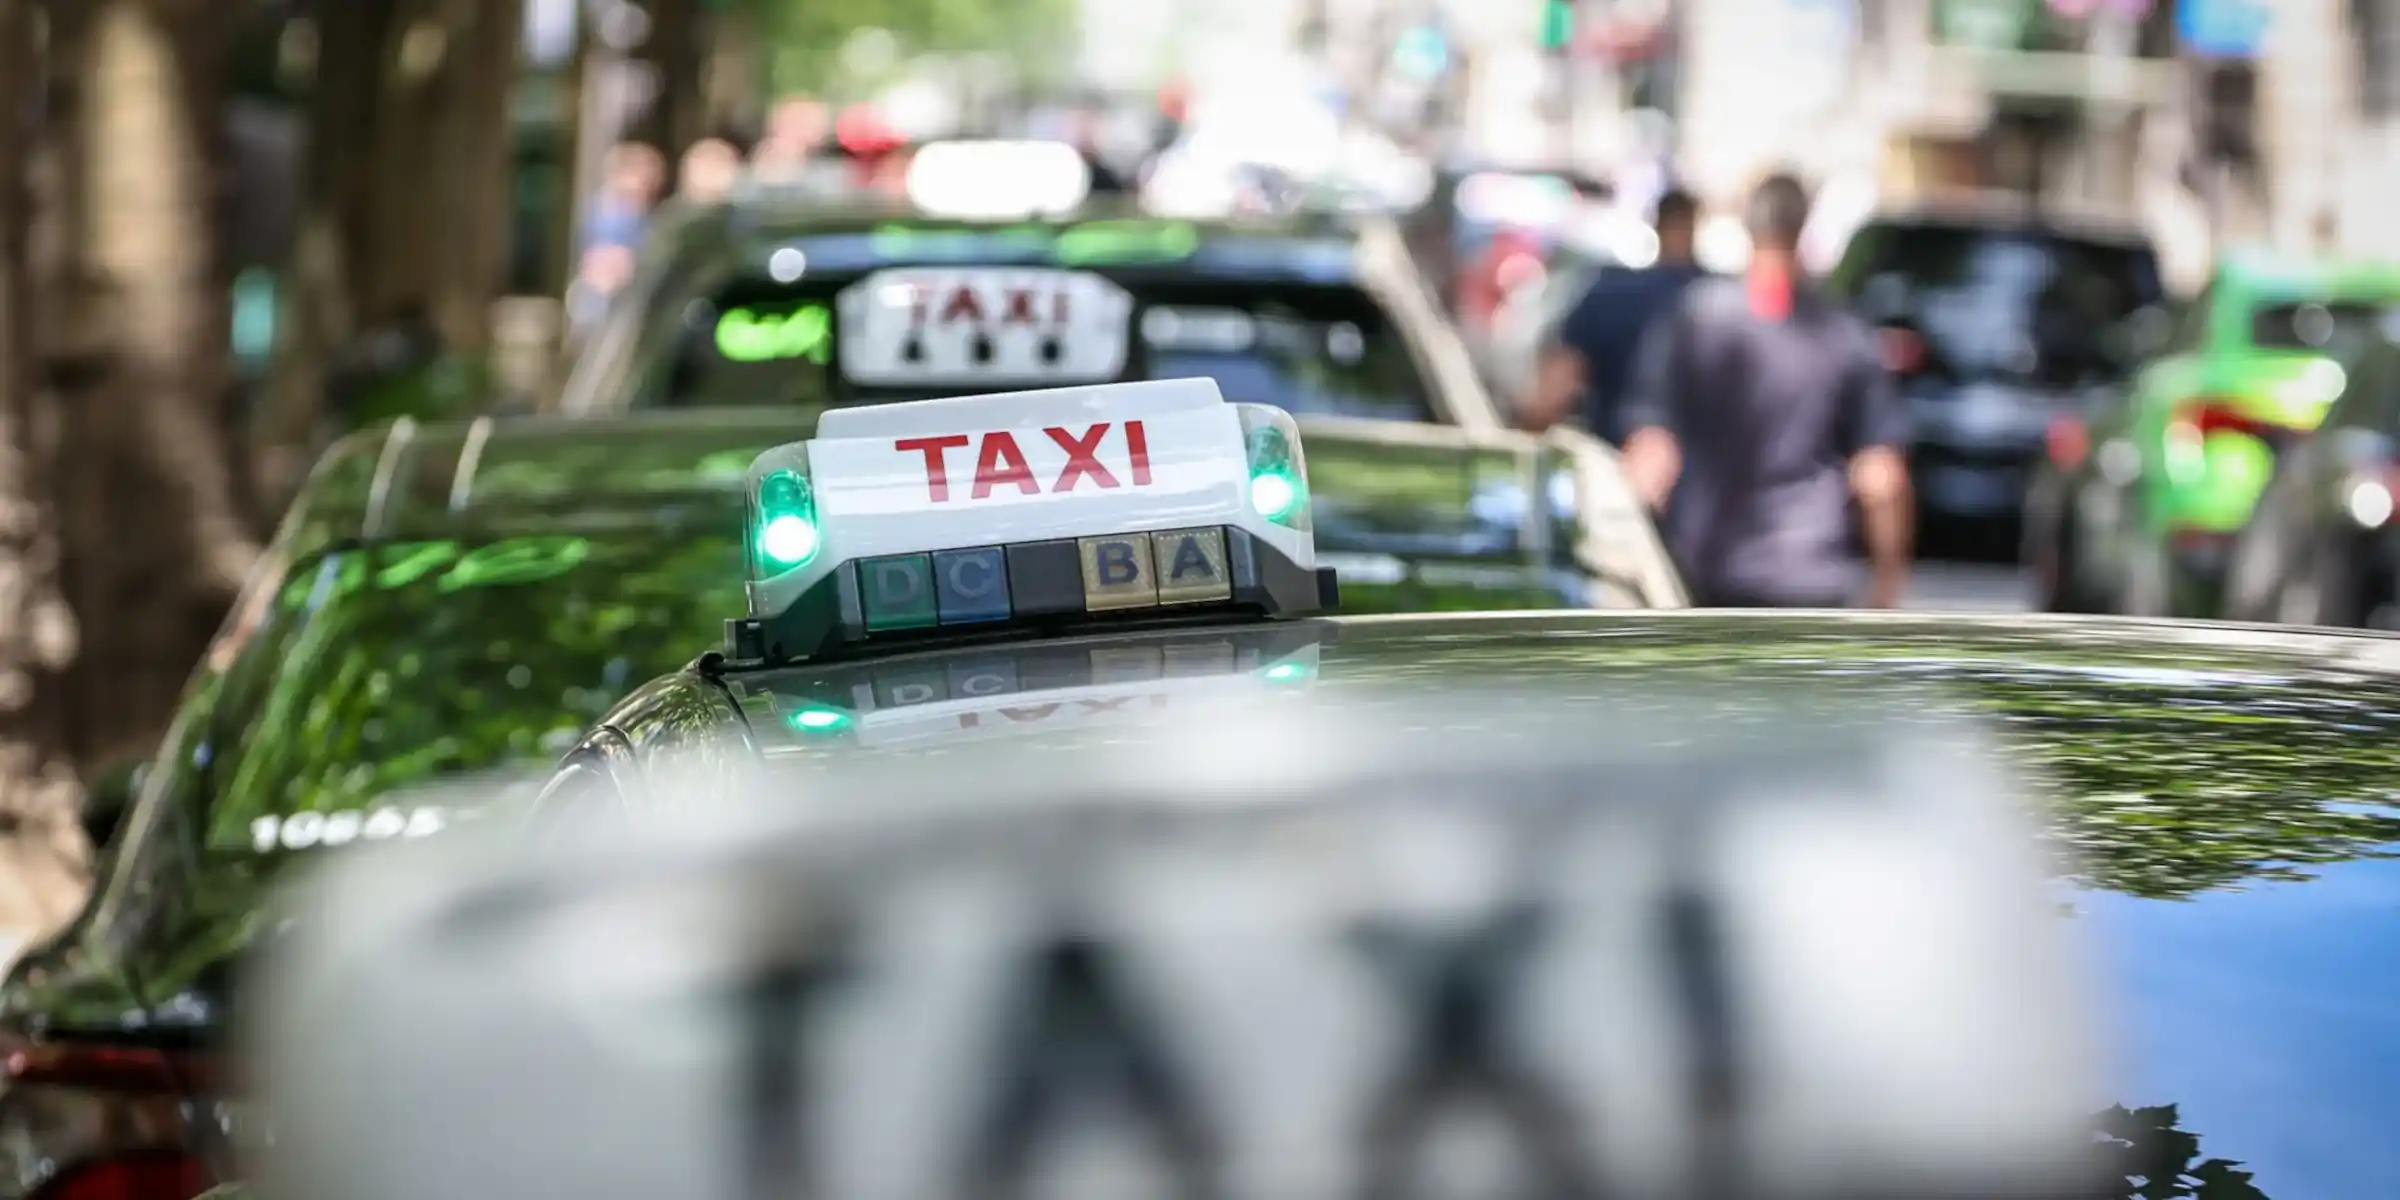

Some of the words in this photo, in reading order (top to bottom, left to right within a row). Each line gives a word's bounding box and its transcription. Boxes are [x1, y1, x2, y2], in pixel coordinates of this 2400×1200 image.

[893, 282, 1070, 326] TAXI
[895, 420, 1152, 502] TAXI
[877, 562, 920, 609] D
[948, 554, 993, 600] C
[1094, 541, 1140, 586] B
[1170, 535, 1215, 579] A
